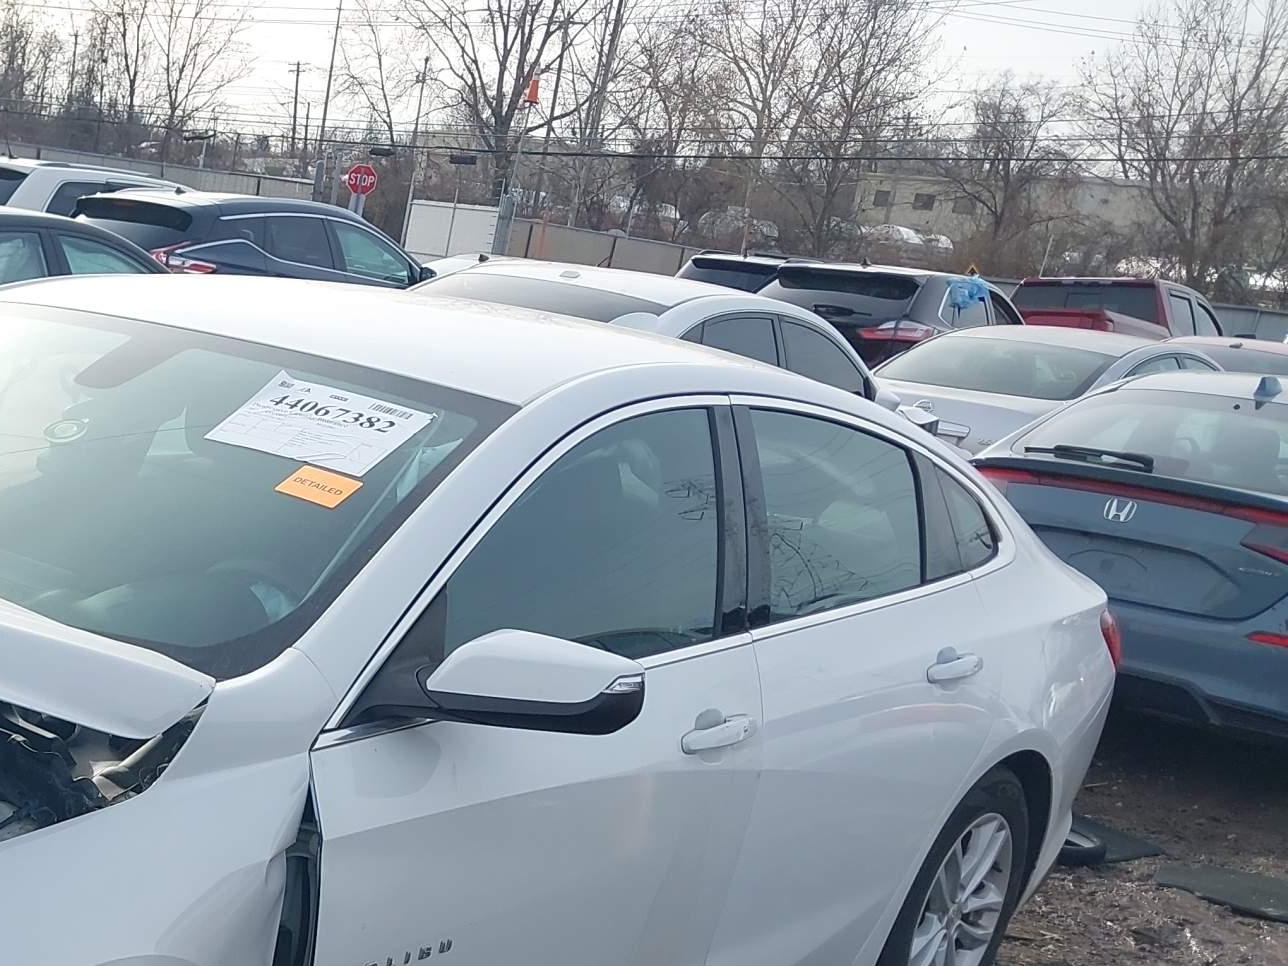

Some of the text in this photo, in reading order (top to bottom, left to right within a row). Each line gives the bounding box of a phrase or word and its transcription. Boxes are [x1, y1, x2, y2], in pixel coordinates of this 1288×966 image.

[349, 173, 374, 187] STOP
[269, 395, 396, 433] 44067382
[292, 476, 344, 497] DETAILED
